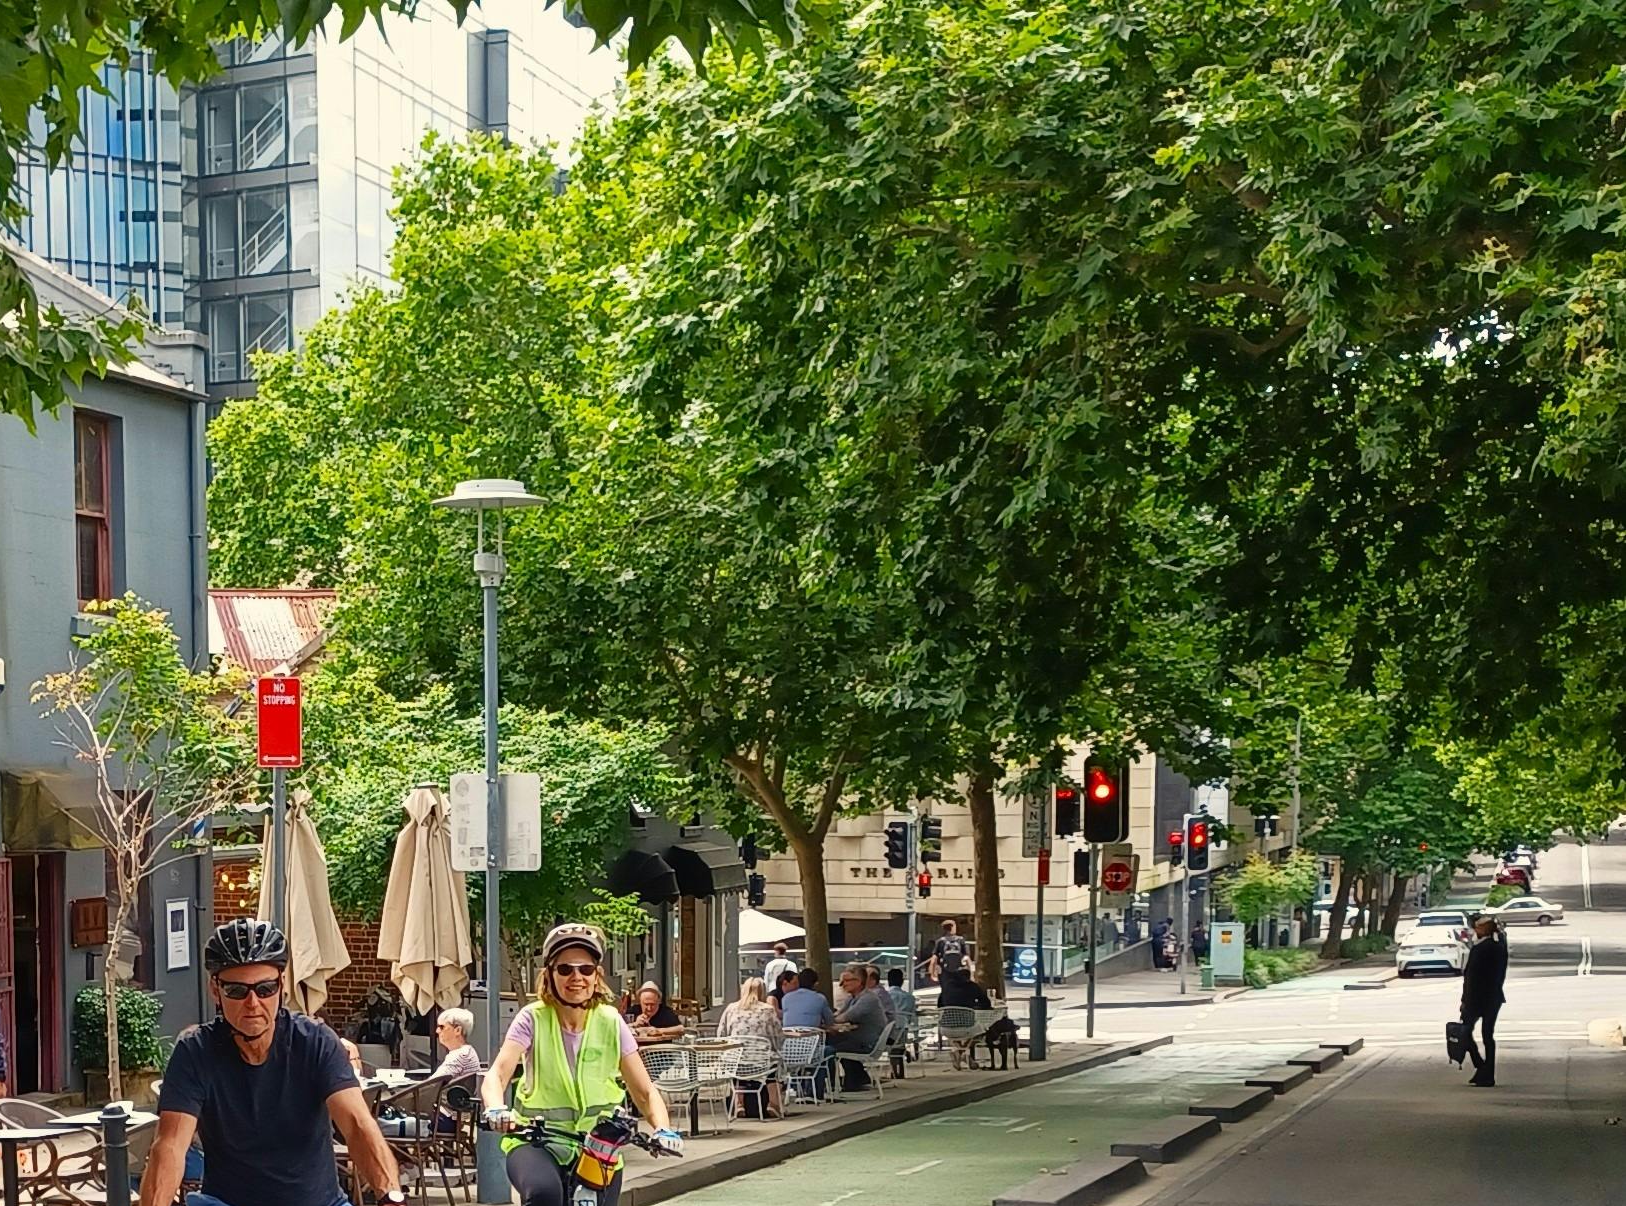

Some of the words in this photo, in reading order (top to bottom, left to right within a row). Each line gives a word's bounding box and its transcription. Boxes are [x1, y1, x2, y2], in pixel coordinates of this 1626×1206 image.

[273, 682, 286, 693] NO
[262, 695, 296, 706] STOPPING
[850, 867, 893, 878] THE
[1104, 871, 1131, 883] STOP
